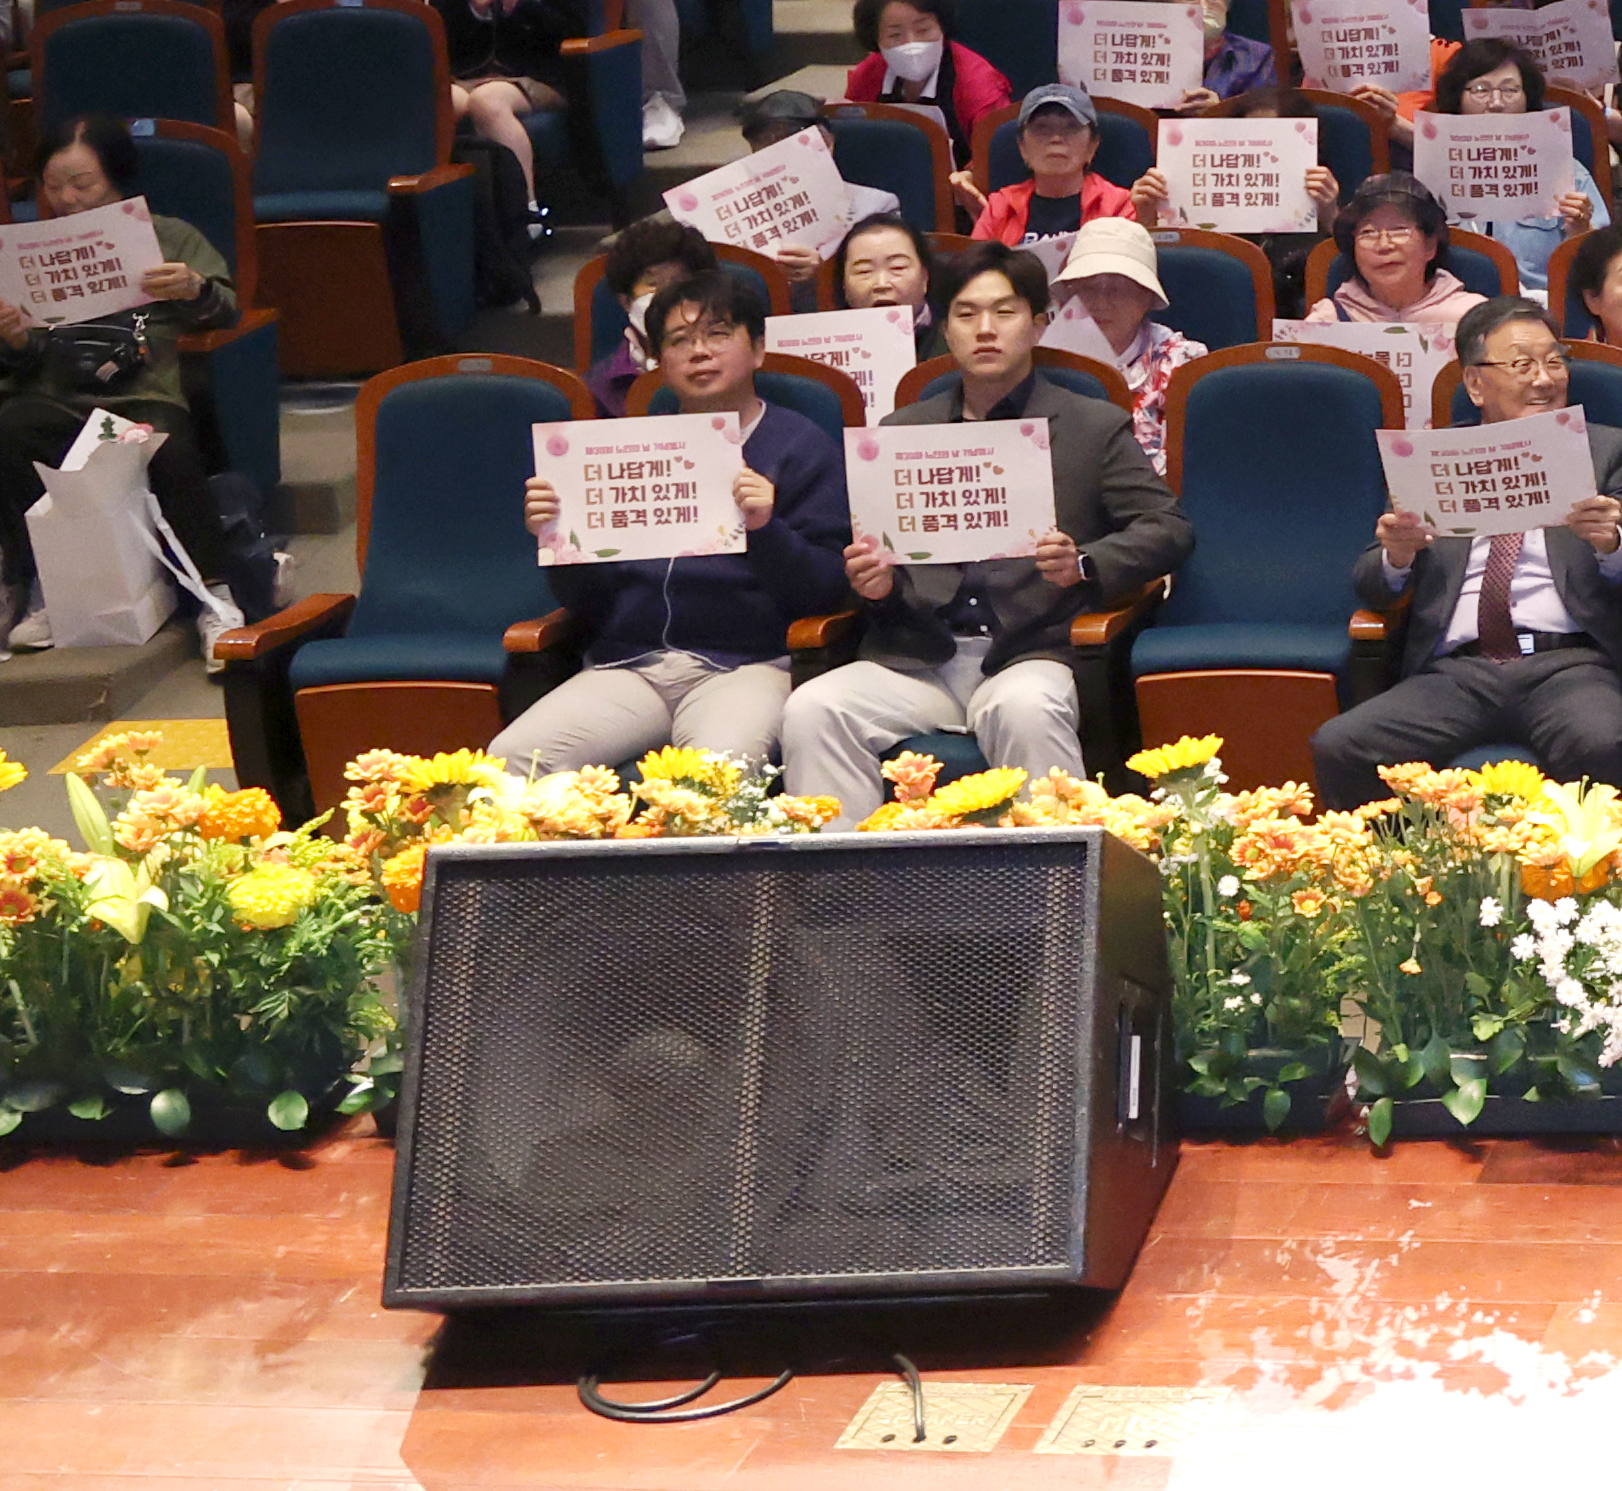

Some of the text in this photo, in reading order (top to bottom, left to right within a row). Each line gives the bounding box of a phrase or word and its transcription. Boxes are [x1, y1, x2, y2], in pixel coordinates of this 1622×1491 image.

[1192, 154, 1260, 168] 더 나답게!
[1193, 173, 1279, 187] 더 가치 있게!
[1193, 192, 1279, 207] 더 품격 있게!
[584, 459, 671, 482] 더 나답게!
[894, 465, 981, 486] 더 나답게!
[1430, 457, 1520, 478] 더 나답게!
[586, 482, 697, 505] 더 가치 있게!
[1435, 472, 1548, 496] 더 가치 있게!
[896, 487, 1007, 510] 더 가치 있게!
[1438, 491, 1551, 514] 더 품격 있게!
[587, 506, 699, 529] 더 품격 있게!
[898, 510, 1009, 533] 더 품격 있게!
[877, 1412, 990, 1426] SPAKER
